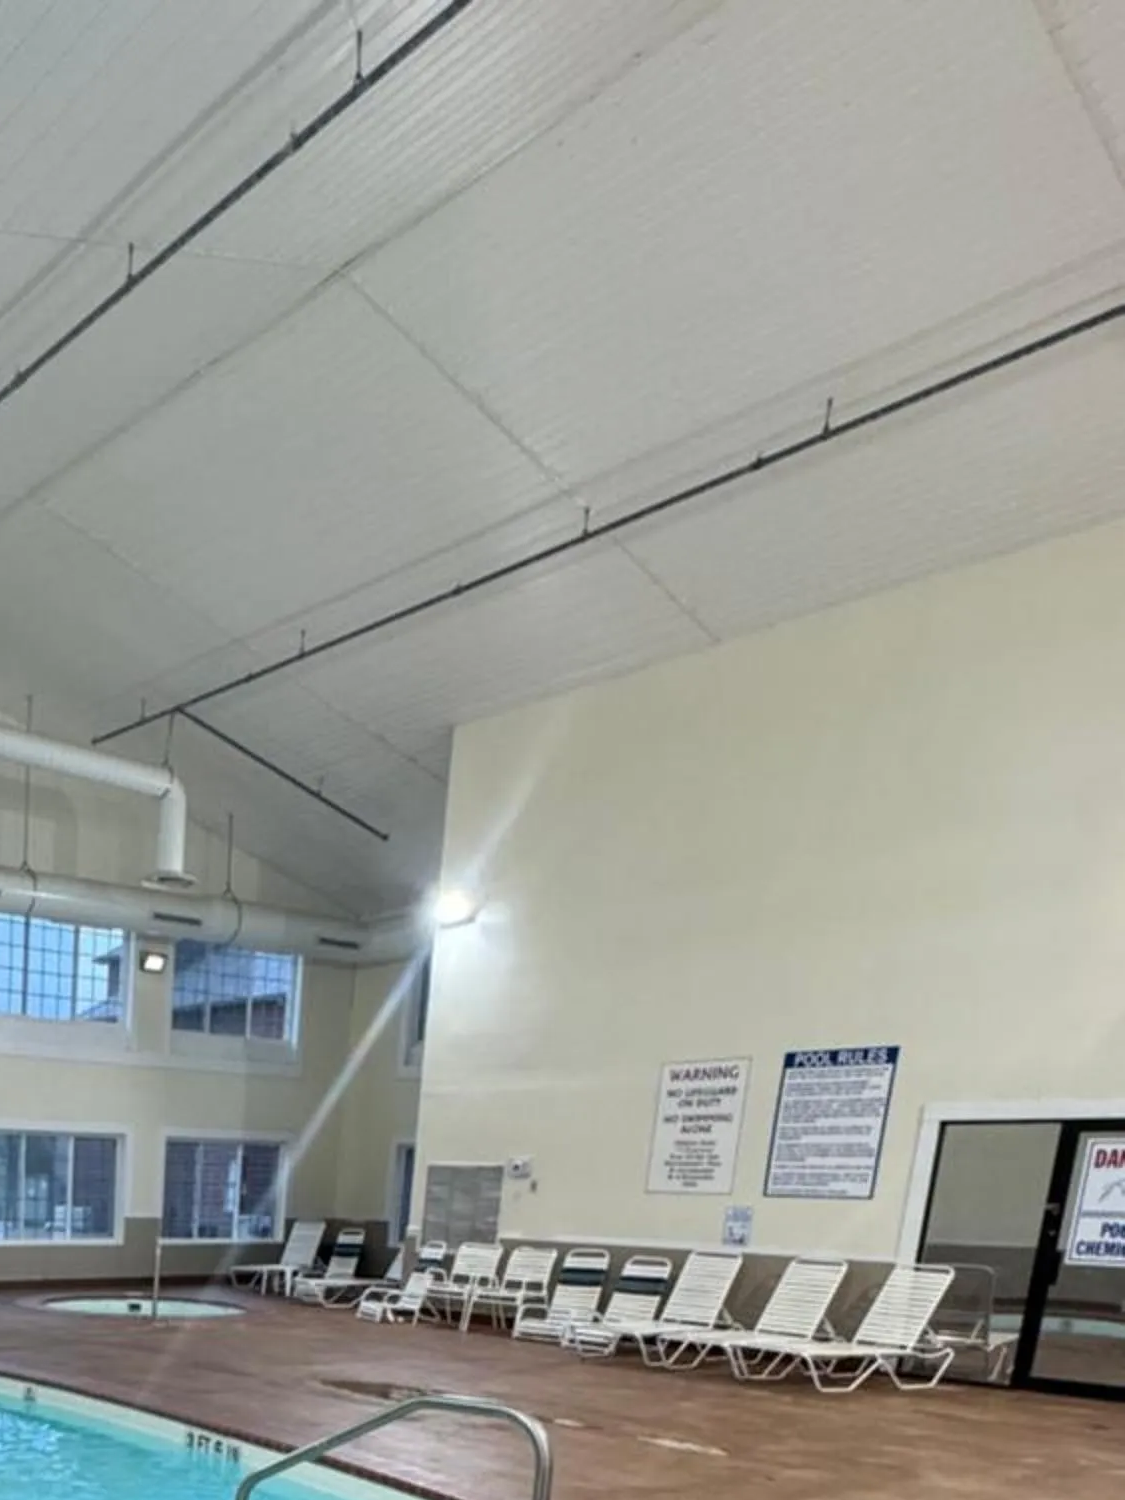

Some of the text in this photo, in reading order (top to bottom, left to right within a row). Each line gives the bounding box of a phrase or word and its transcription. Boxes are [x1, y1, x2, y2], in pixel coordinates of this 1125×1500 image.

[794, 1047, 888, 1067] POOL RULES
[669, 1064, 739, 1081] WARNING
[666, 1086, 738, 1098] NO LIFEGUARD
[696, 1098, 721, 1108] DUTY
[663, 1113, 734, 1123] NO SWIMMING
[679, 1124, 713, 1134] ALONE
